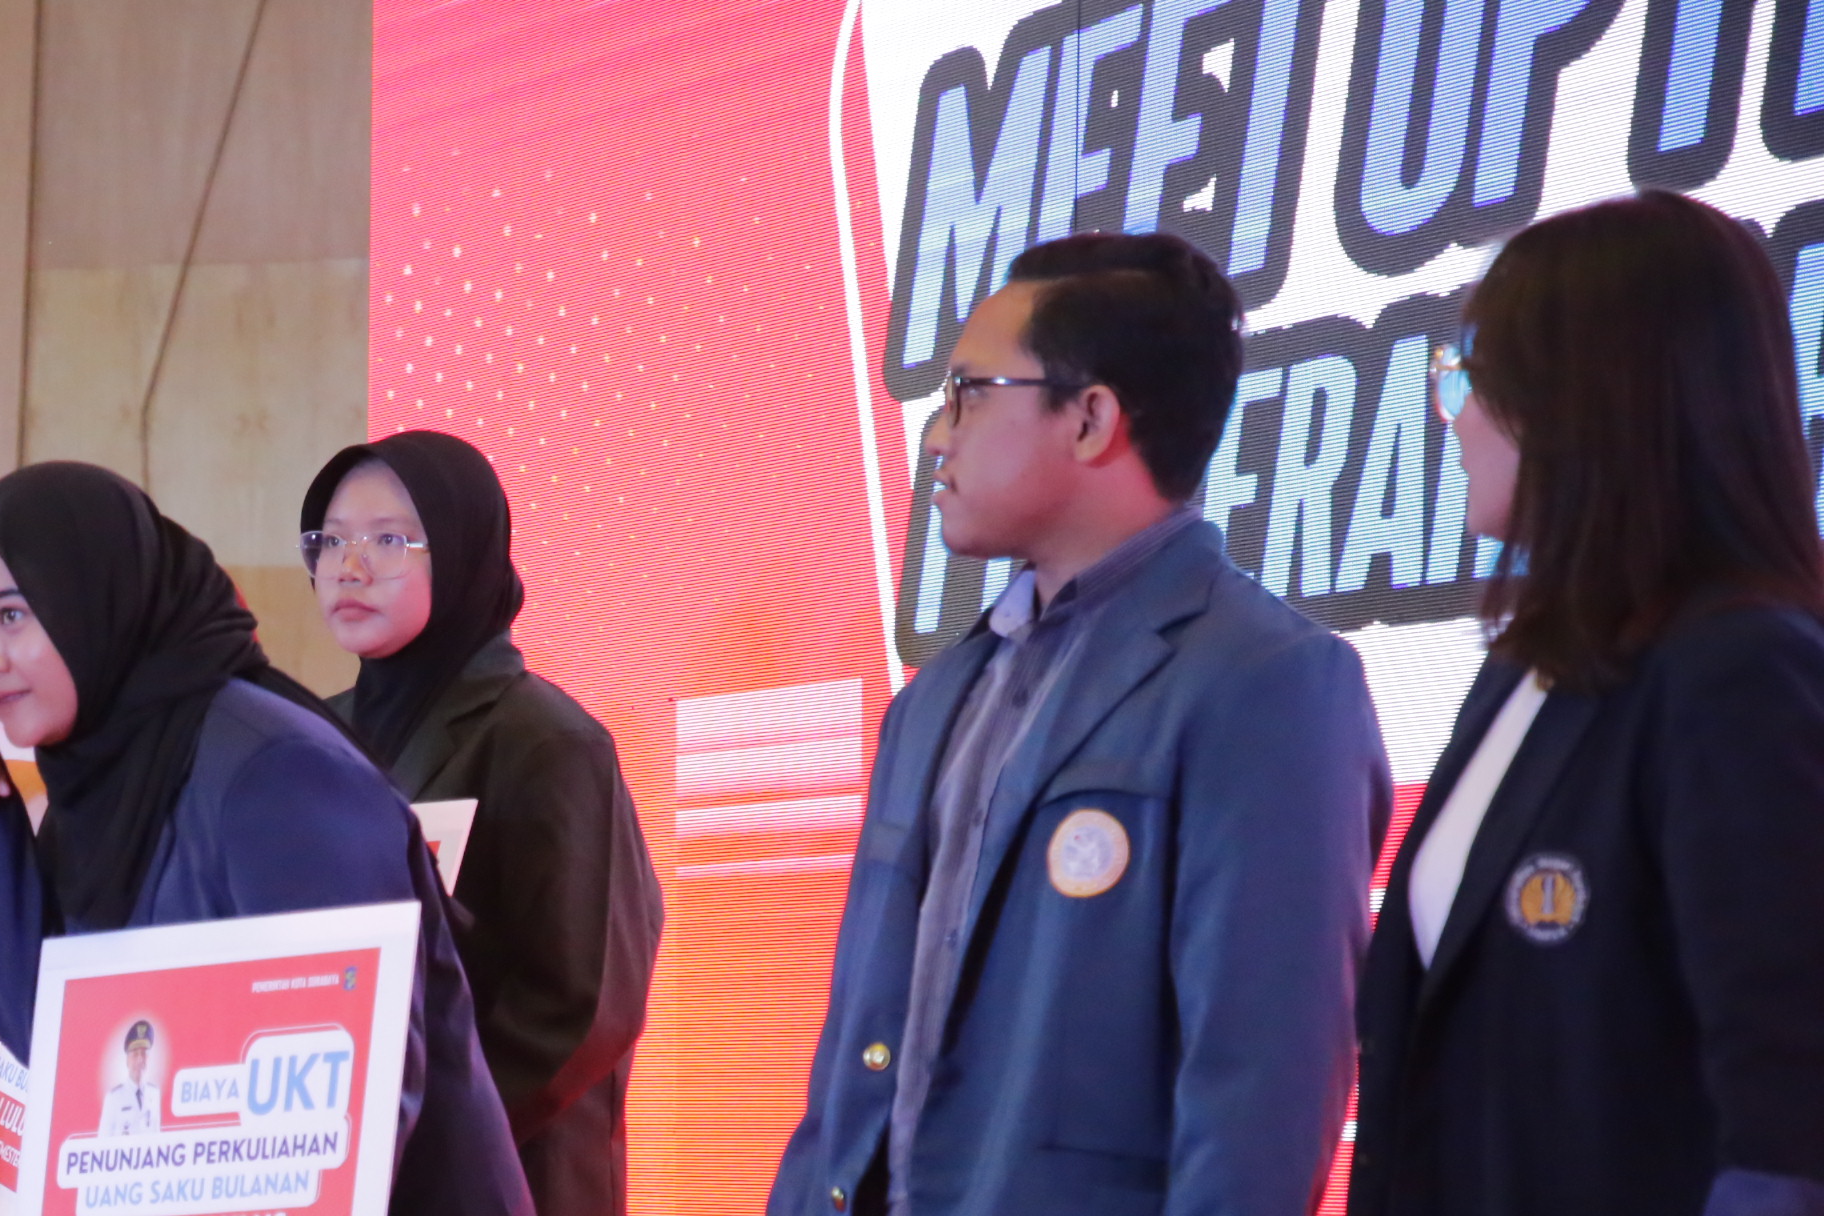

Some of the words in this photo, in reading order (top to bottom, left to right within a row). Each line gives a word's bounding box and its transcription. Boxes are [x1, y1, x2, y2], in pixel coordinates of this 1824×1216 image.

[180, 1078, 240, 1104] BIAYA
[247, 1050, 350, 1116] UKT
[65, 1142, 186, 1176] PENUNJANG
[192, 1131, 338, 1166] PERKULIAHAN
[85, 1181, 143, 1209] UANG
[149, 1177, 206, 1204] SAKU
[211, 1169, 310, 1200] BULANAN
